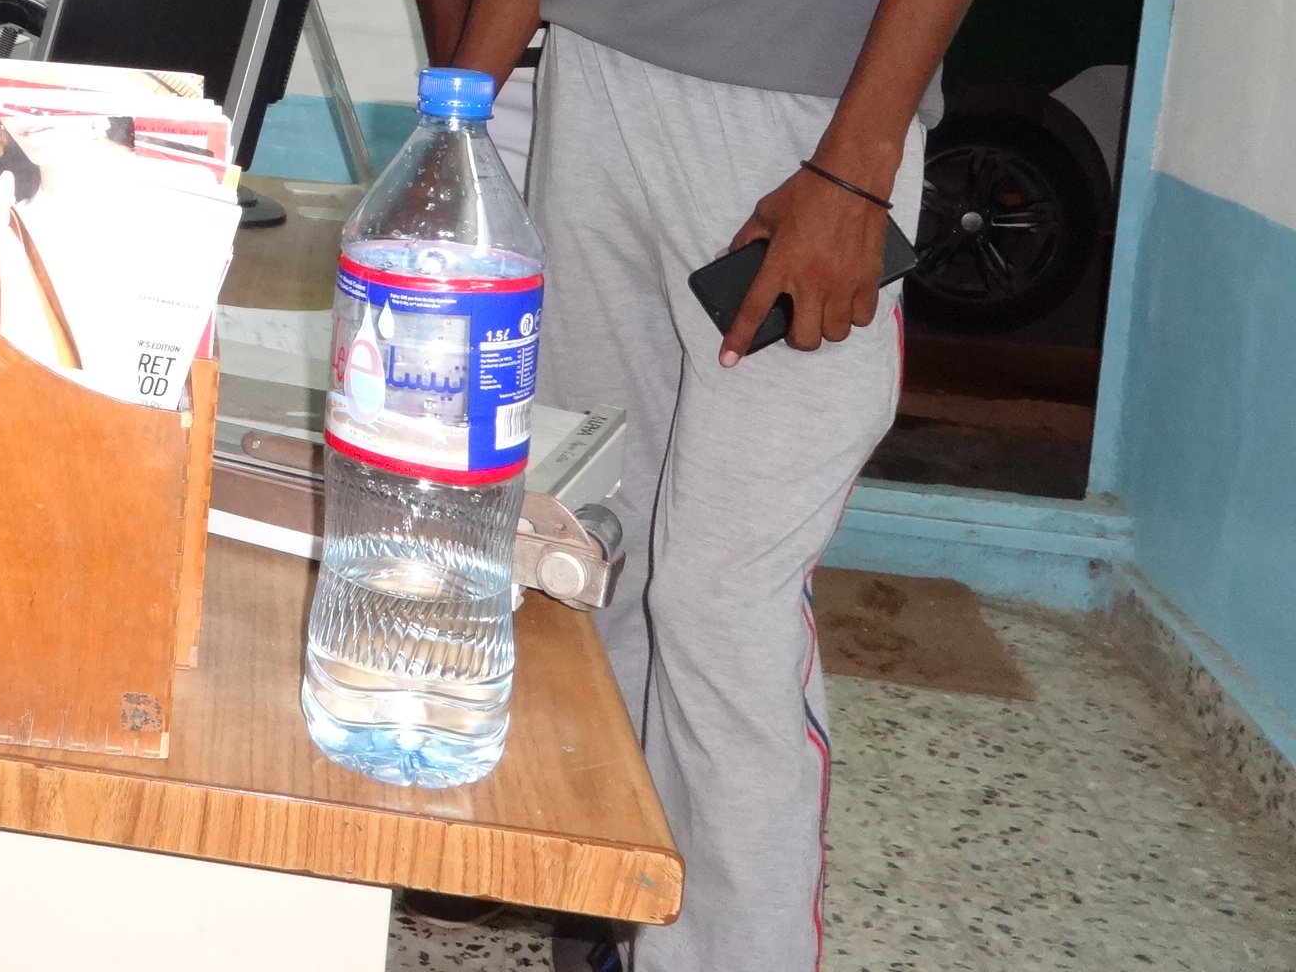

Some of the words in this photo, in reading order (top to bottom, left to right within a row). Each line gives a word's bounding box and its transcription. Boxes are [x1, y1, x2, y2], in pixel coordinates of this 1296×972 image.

[137, 339, 151, 348] R'S
[151, 342, 181, 353] EDITION
[138, 375, 169, 397] OD
